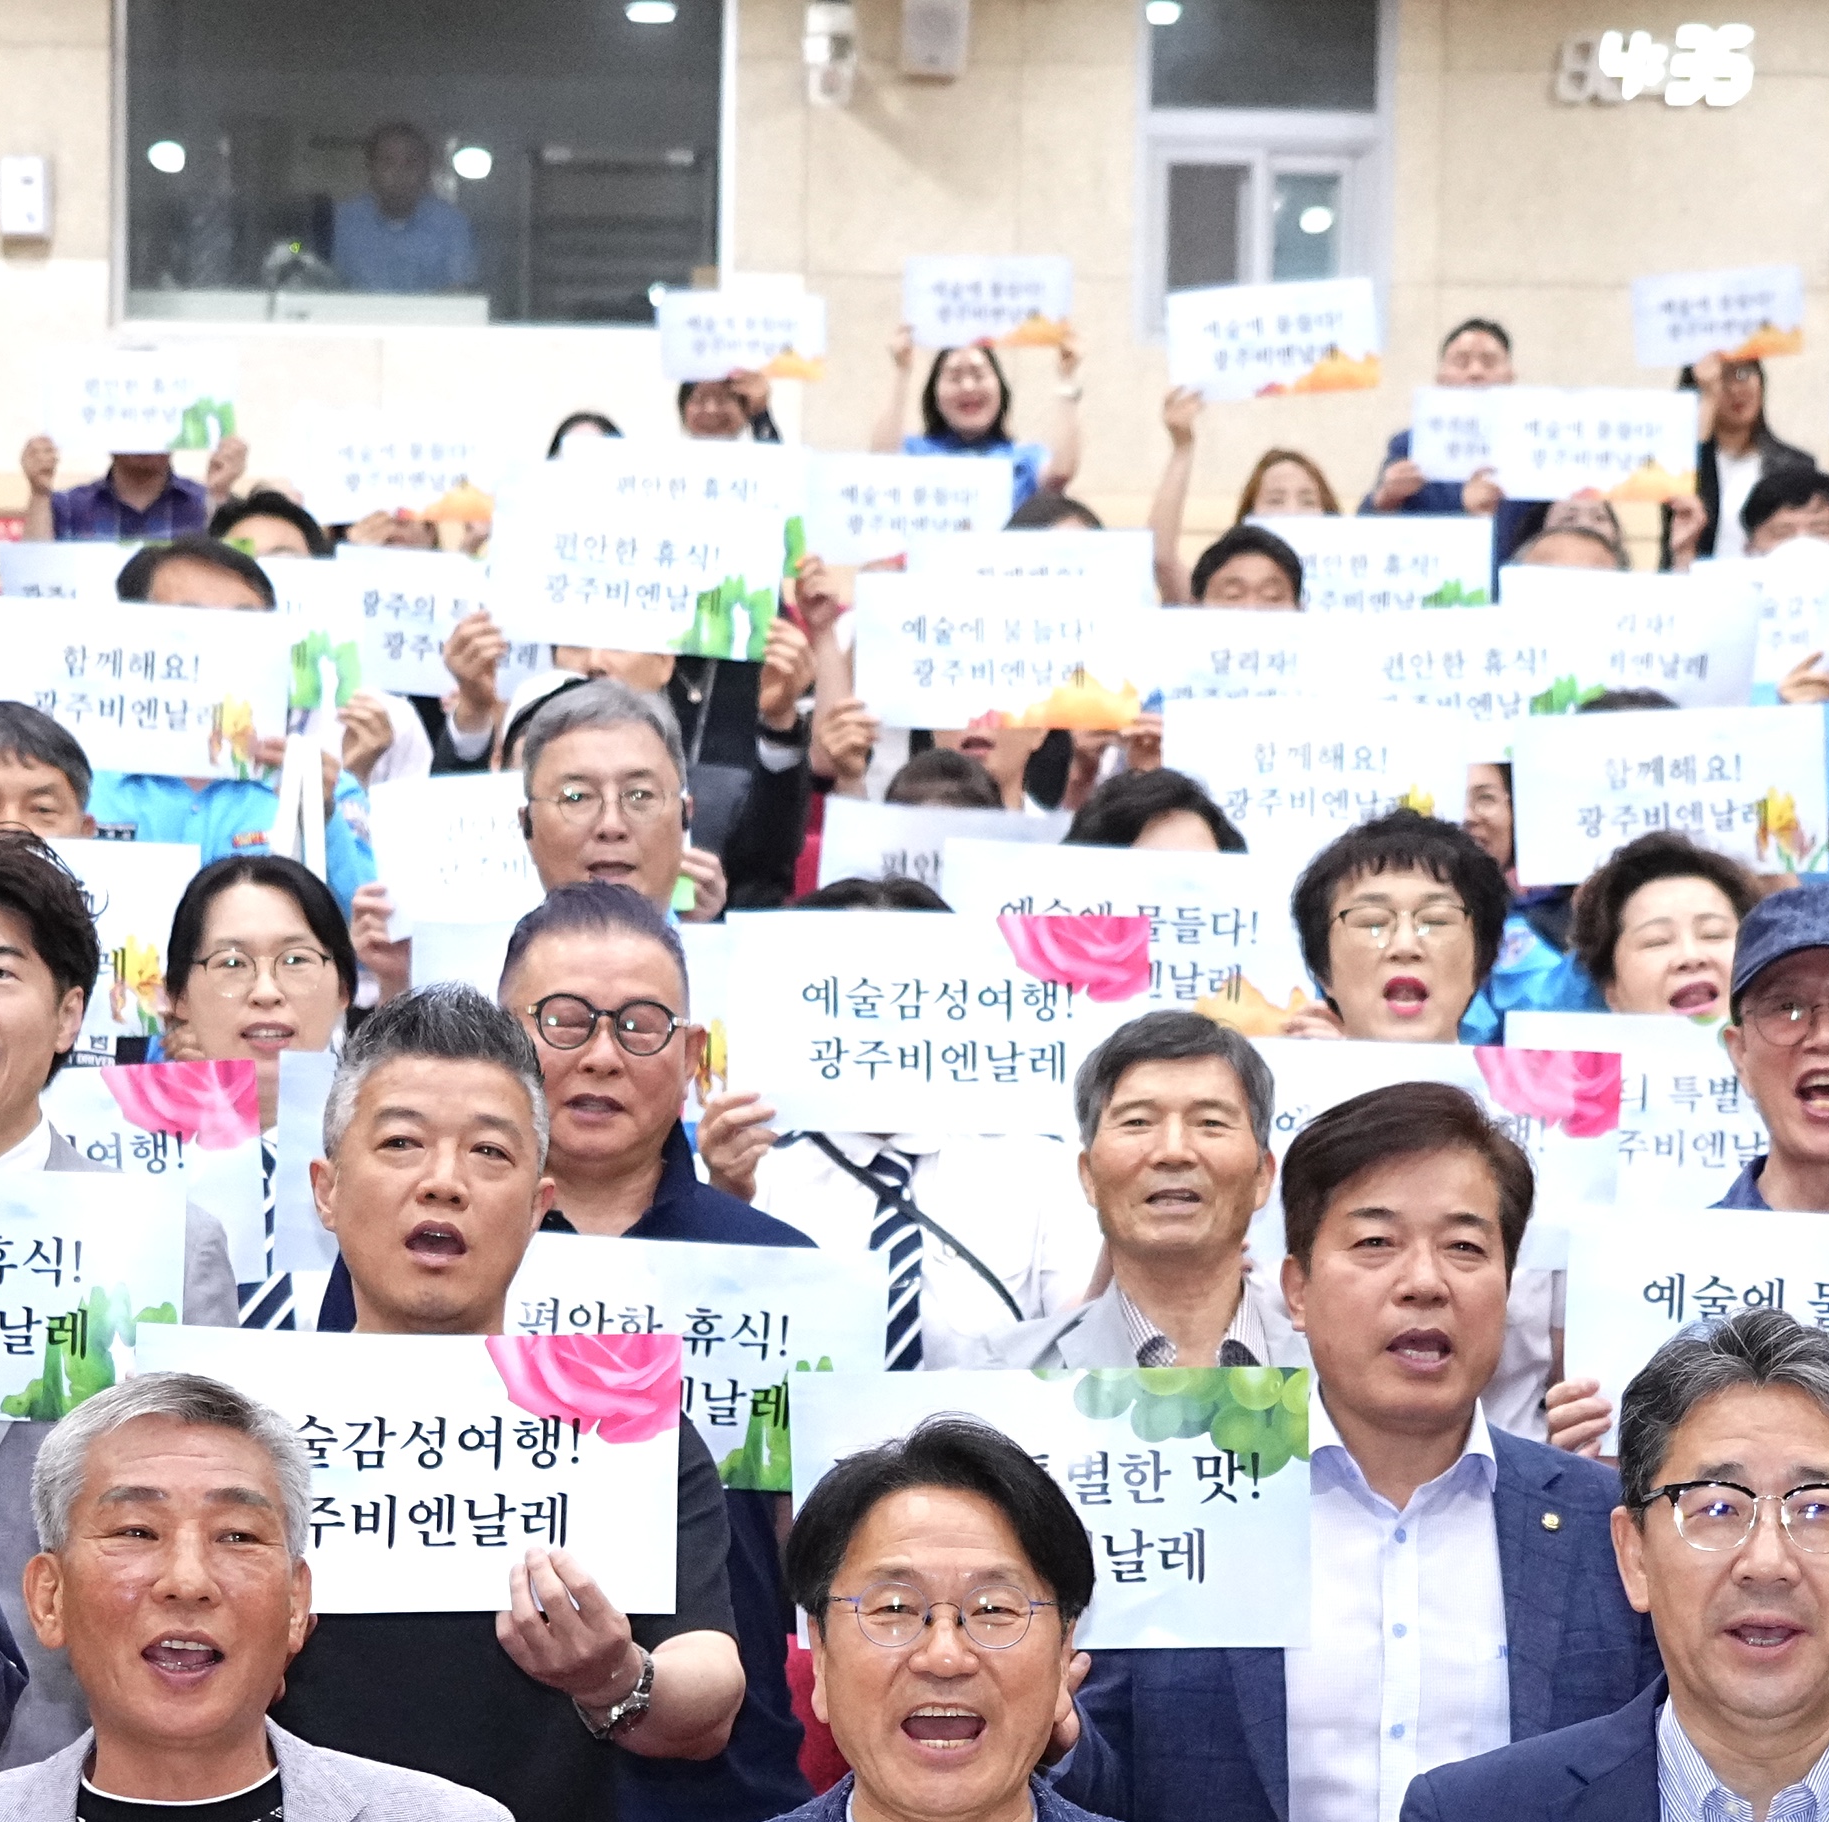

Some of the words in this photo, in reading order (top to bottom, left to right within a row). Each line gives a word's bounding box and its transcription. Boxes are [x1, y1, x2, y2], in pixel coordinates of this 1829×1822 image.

[554, 533, 639, 570] 편안한
[653, 542, 721, 571] 휴식!
[362, 590, 437, 623] 광주의
[544, 572, 723, 618] 광주비엔날레
[902, 615, 985, 645] 예술에
[1002, 618, 1096, 647] 물들다!
[64, 647, 200, 681] 함께해요!
[911, 656, 1086, 689] 광주비엔날레
[1210, 648, 1299, 677] 달리자!
[1382, 649, 1467, 678] 편안한
[1484, 648, 1549, 677] 휴식!
[1608, 650, 1708, 679] 비엔날레
[34, 691, 227, 731] 광주비엔날레
[1253, 743, 1388, 776] 함께해요!
[1605, 754, 1743, 788] 함께해요!
[1223, 784, 1410, 820] 광주비엔날레
[1575, 798, 1769, 840] 광주비엔날레
[802, 977, 1075, 1024] 예술감성여행!
[808, 1038, 1067, 1085] 광주비엔날레
[682, 1306, 790, 1361] 휴식!
[1194, 1447, 1262, 1506] 맛!
